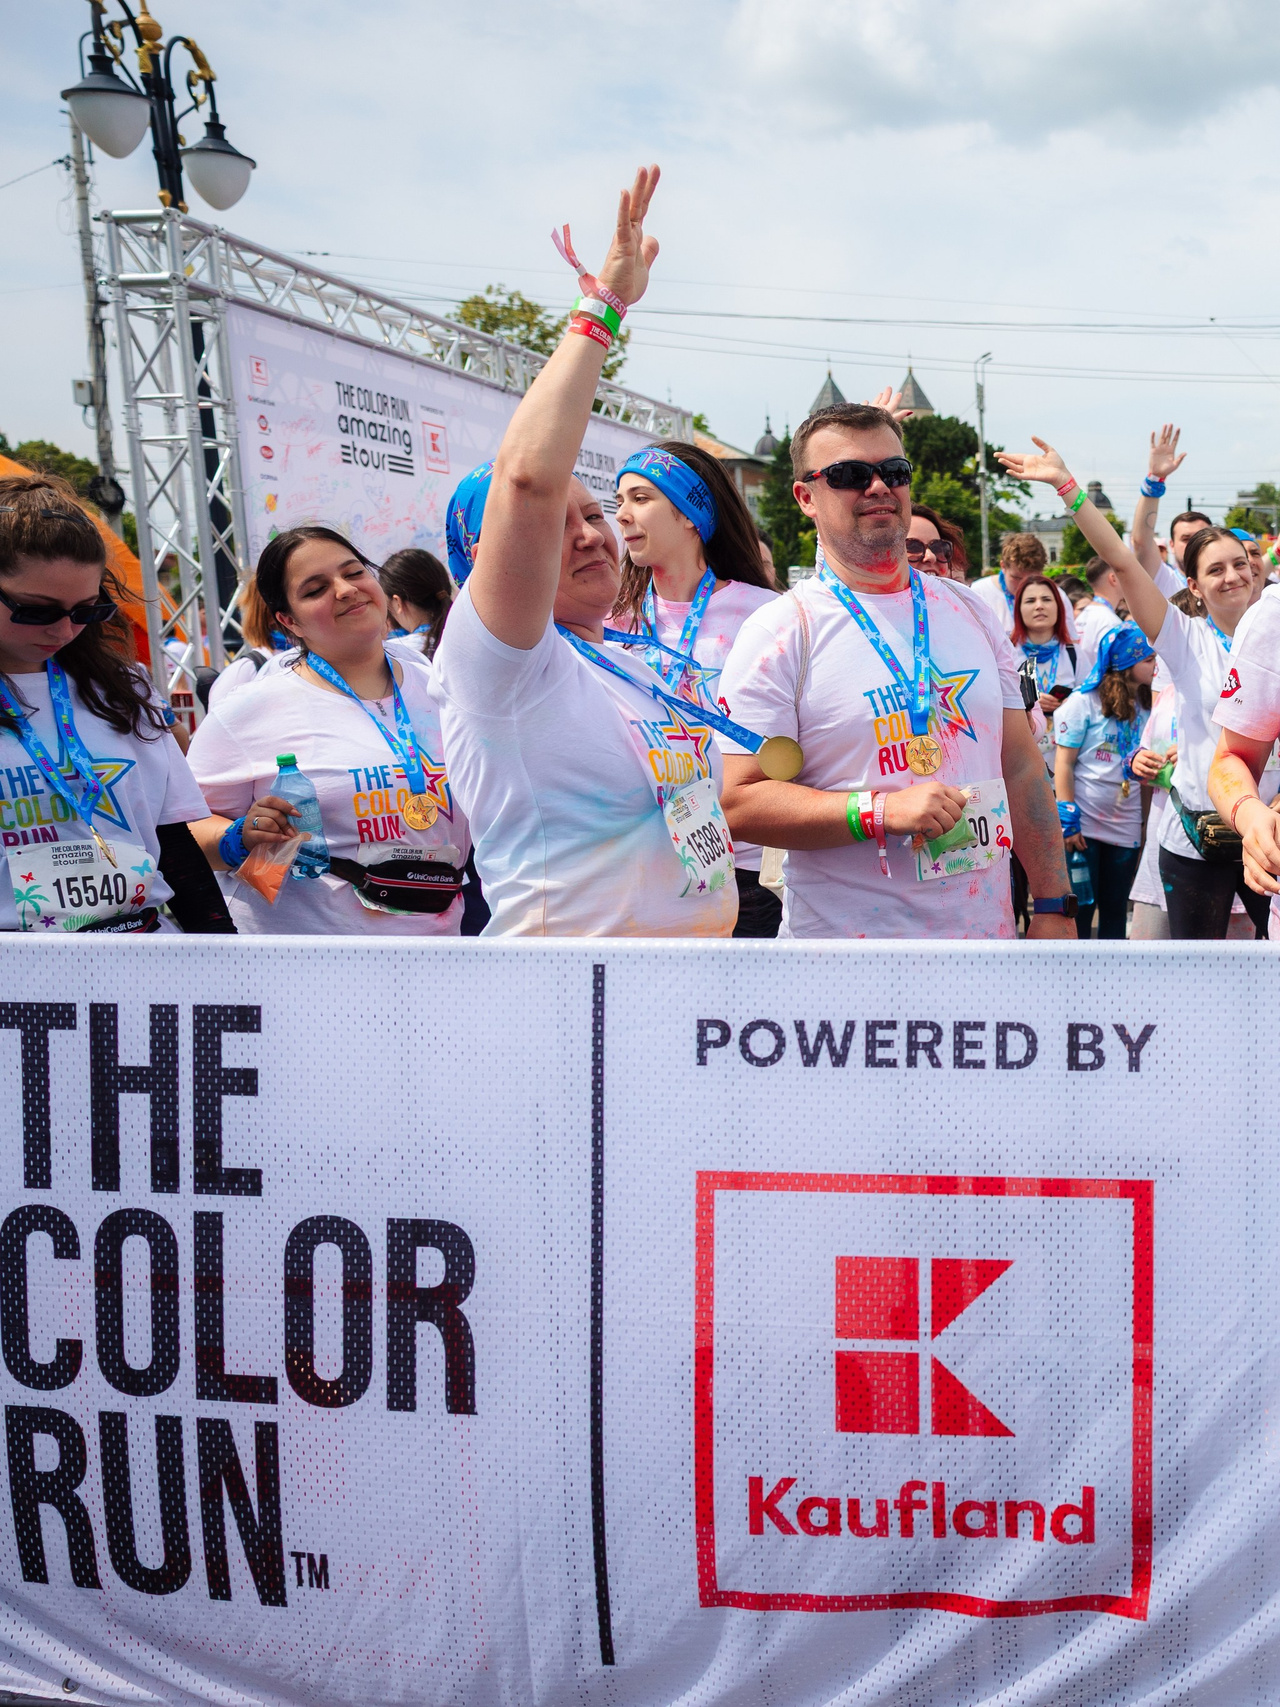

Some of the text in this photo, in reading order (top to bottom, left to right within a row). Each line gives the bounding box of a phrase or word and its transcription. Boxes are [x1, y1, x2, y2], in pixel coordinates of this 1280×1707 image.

[598, 286, 627, 316] GUEST
[335, 381, 356, 409] THE
[357, 387, 390, 416] COLOR
[338, 414, 412, 455] amazing
[352, 441, 386, 470] tour
[587, 650, 615, 669] THE COLOR
[873, 706, 941, 747] COLR
[39, 757, 53, 772] COLOR
[878, 741, 910, 776] RU
[348, 765, 393, 792] THE
[352, 788, 410, 818] COLO
[874, 797, 885, 825] GUEST
[357, 815, 401, 843] RUN
[687, 821, 726, 869] 15389
[52, 851, 93, 860] amazing
[52, 873, 127, 908] 15540
[414, 873, 440, 882] UniCredit
[127, 919, 143, 929] Bank
[696, 1018, 1158, 1073] POWERED BY
[0, 1001, 262, 1197] THE
[0, 1204, 478, 1416] COLOR
[4, 1404, 288, 1607] RUN
[747, 1475, 1096, 1544] Kaufland
